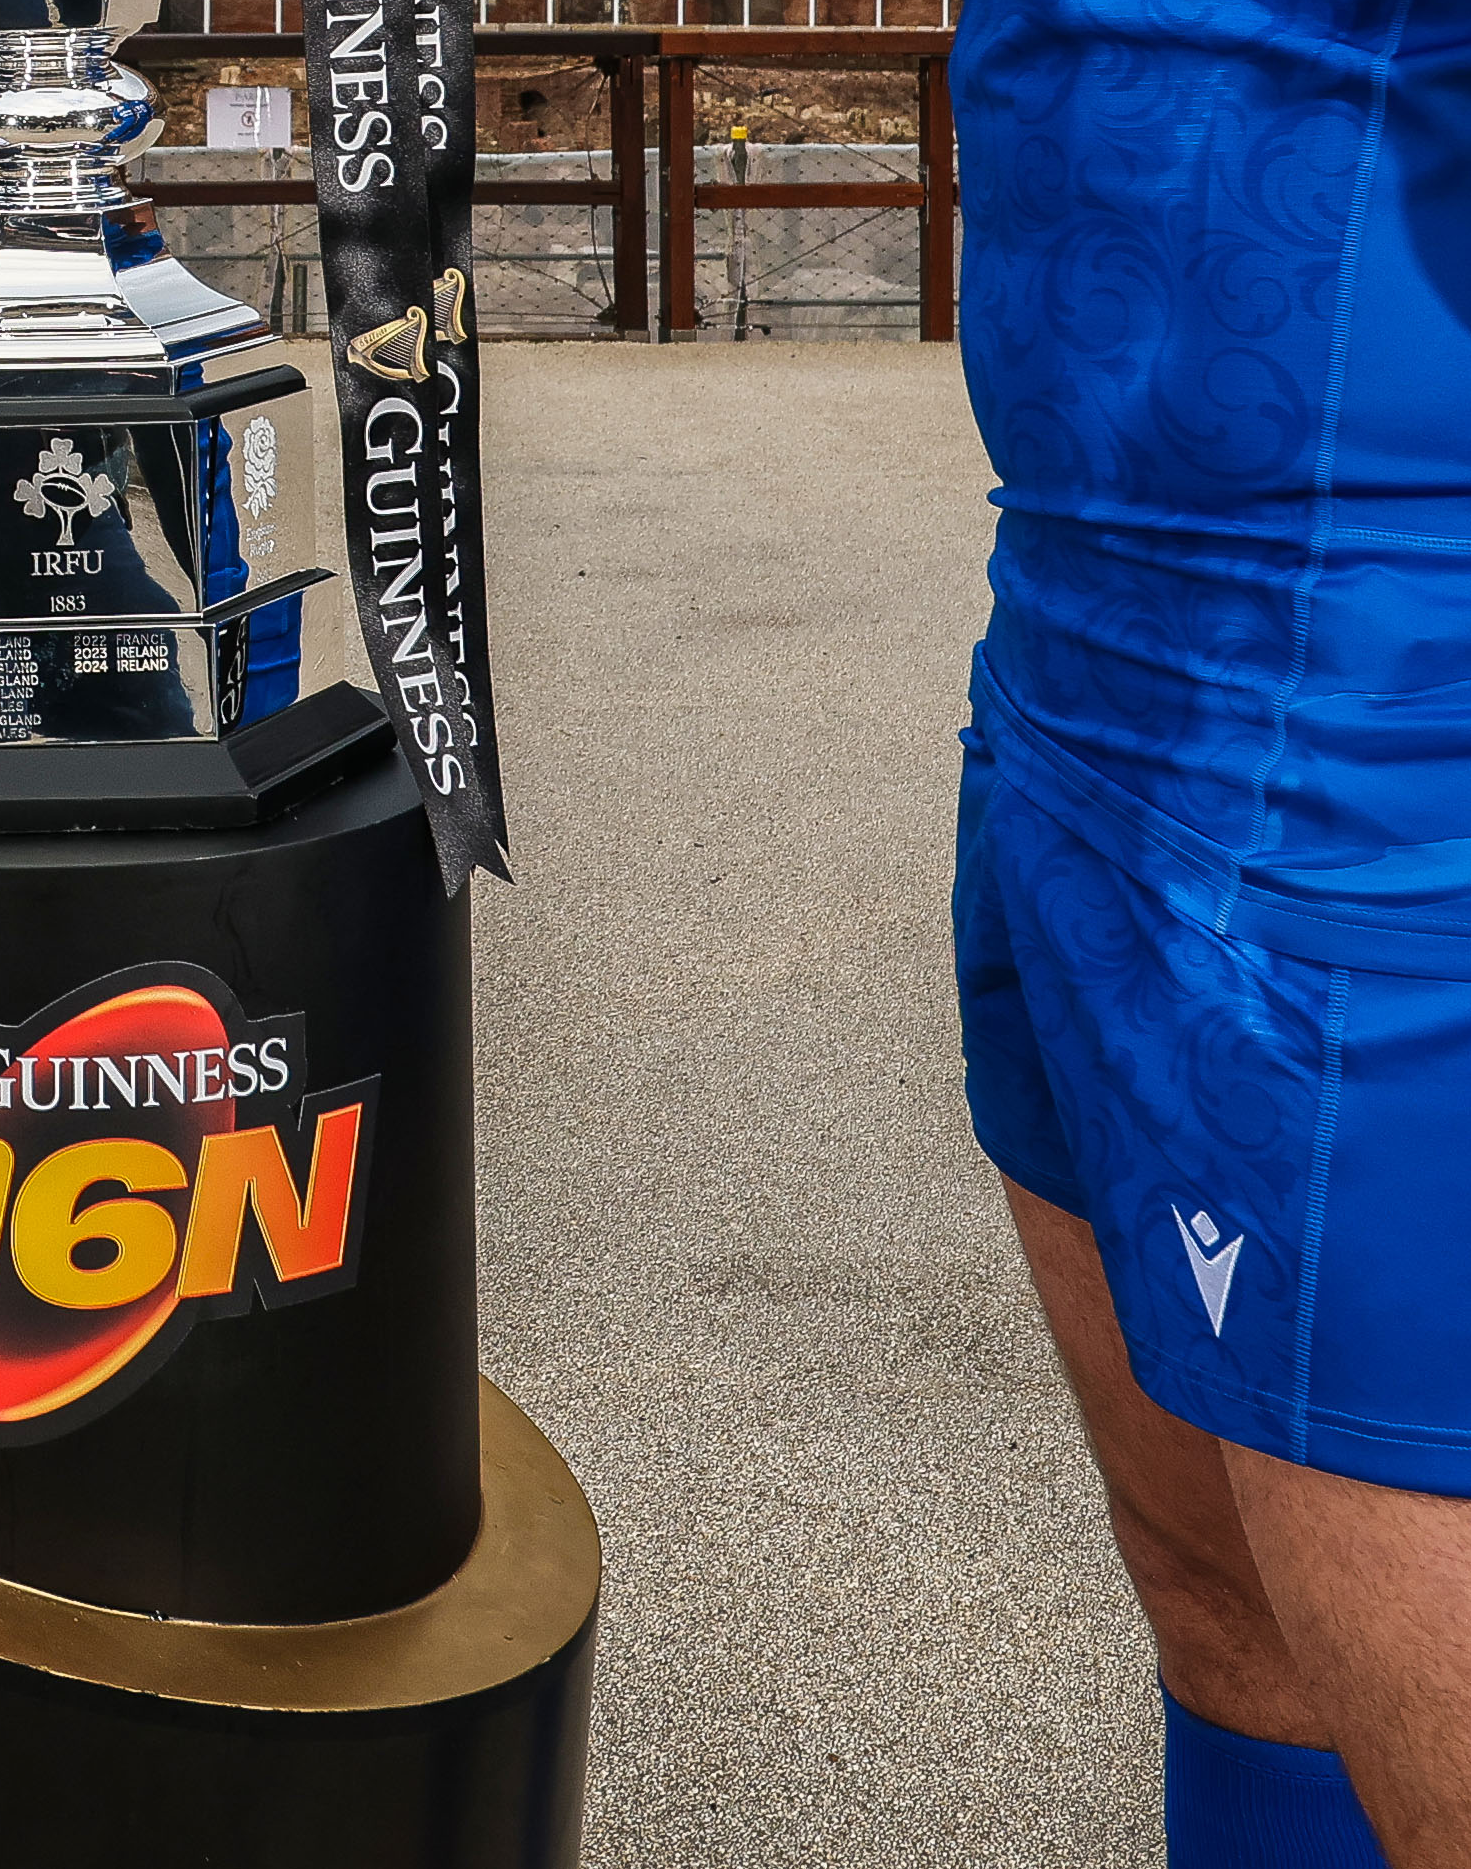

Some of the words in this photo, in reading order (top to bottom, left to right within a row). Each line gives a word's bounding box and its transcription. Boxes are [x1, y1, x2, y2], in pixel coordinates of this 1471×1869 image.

[31, 549, 104, 576] IRFU
[50, 594, 86, 612] 1883
[364, 395, 467, 797] GUINNESS
[74, 634, 107, 646] 2022
[116, 633, 166, 646] FRANCE
[74, 647, 108, 659] 2023
[116, 645, 169, 658] IRELAND
[74, 660, 109, 673] 2024
[116, 658, 169, 672] IRELAND
